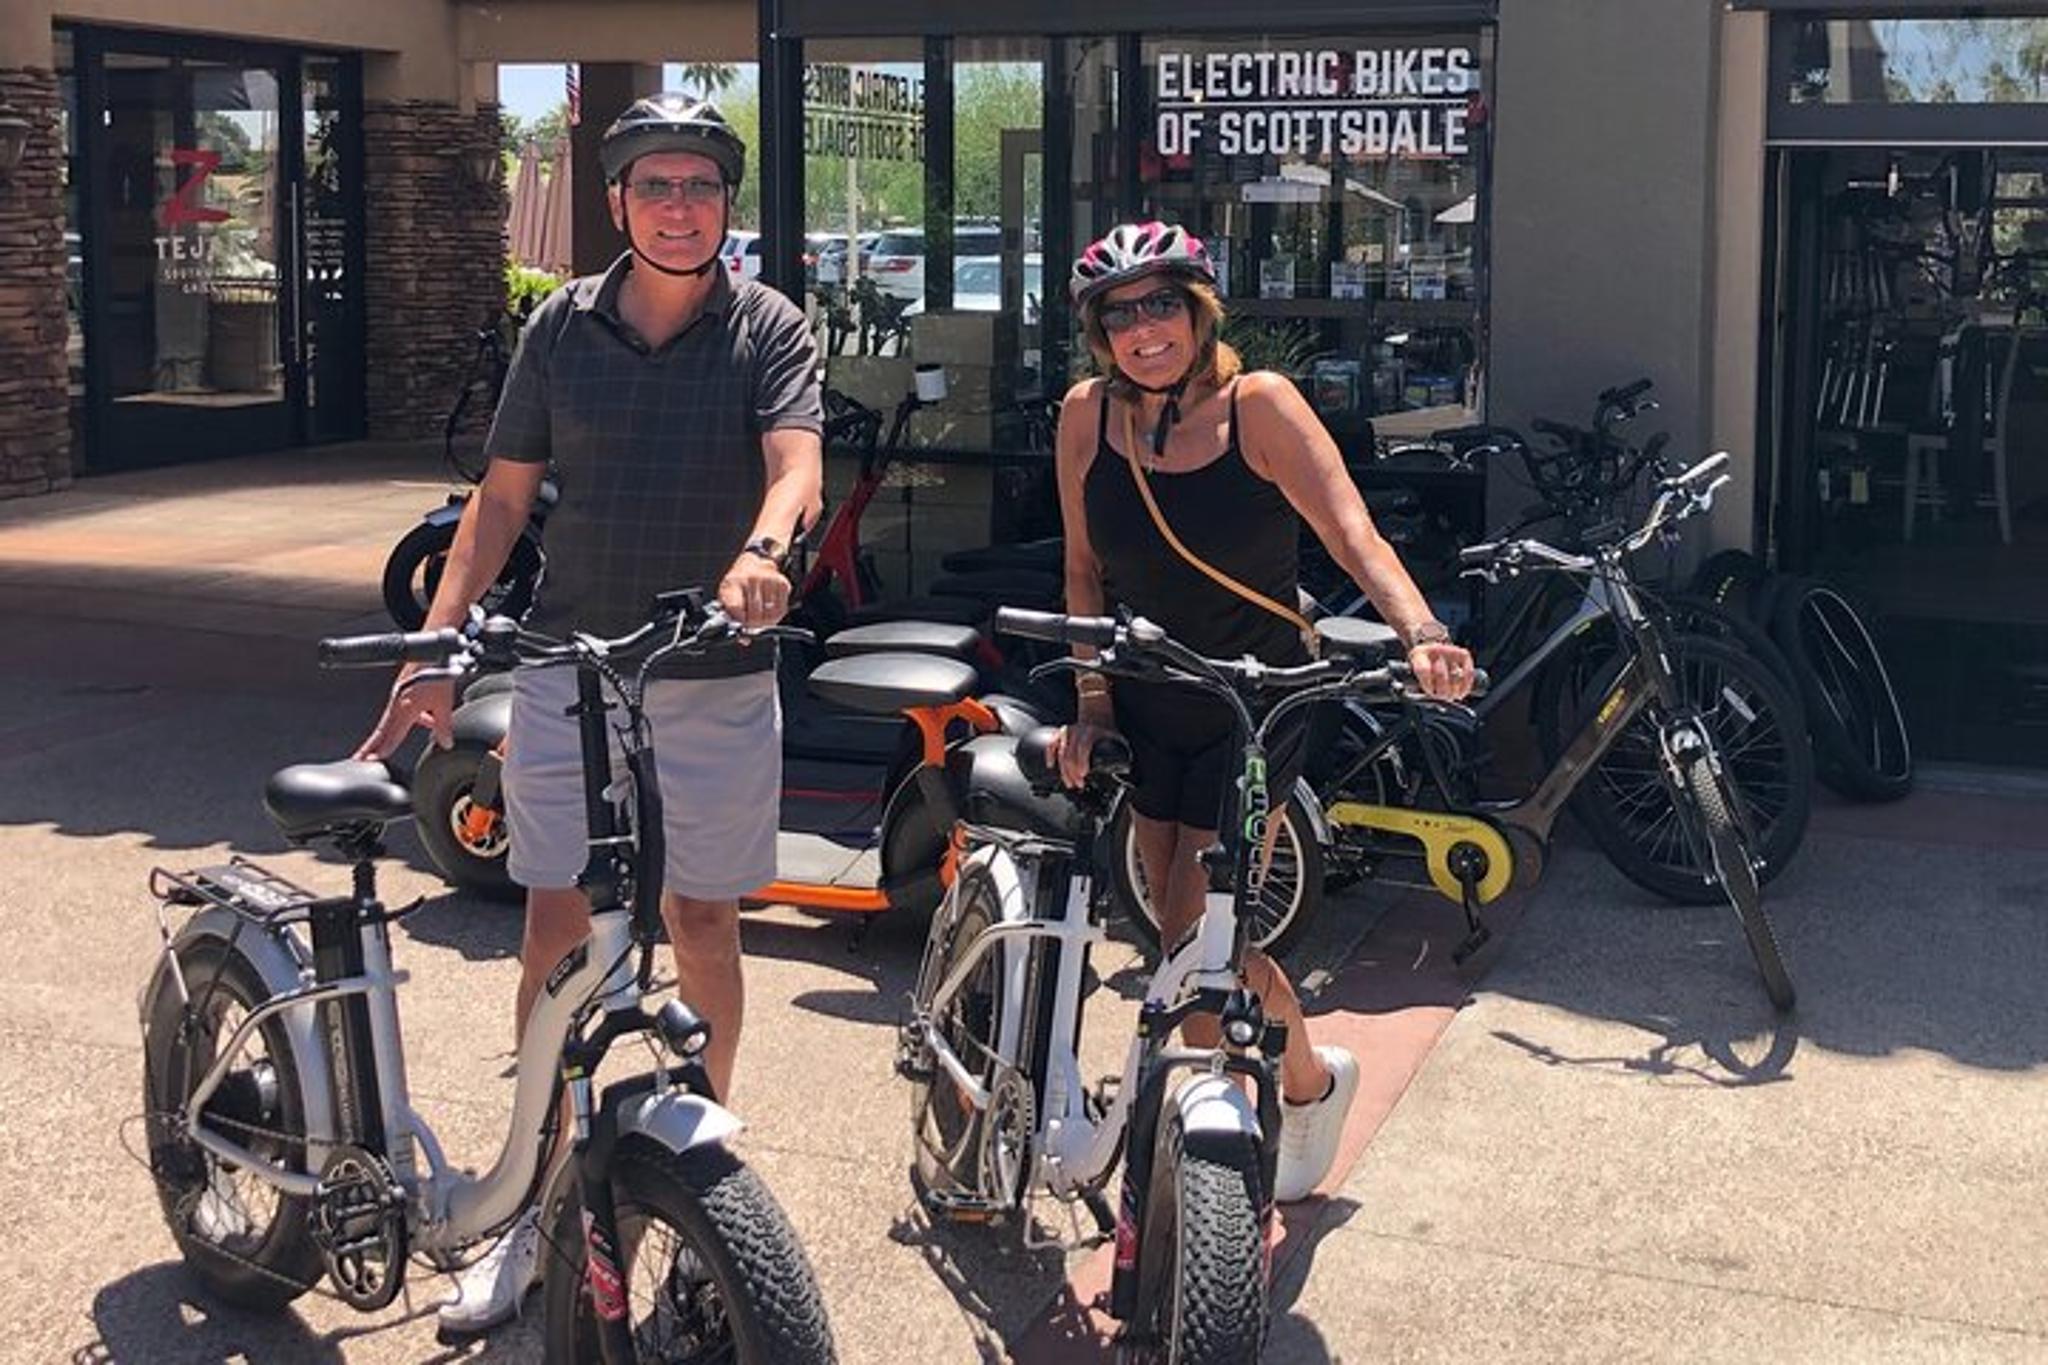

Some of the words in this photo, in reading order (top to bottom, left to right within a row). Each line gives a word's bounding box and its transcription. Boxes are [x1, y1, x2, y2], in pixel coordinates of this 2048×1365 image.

[1158, 50, 1338, 98] ELECTRIC
[1355, 47, 1470, 95] BIKES
[1158, 112, 1204, 155] OF
[1219, 108, 1469, 155] SCOTTSDALE
[160, 147, 231, 229] Z
